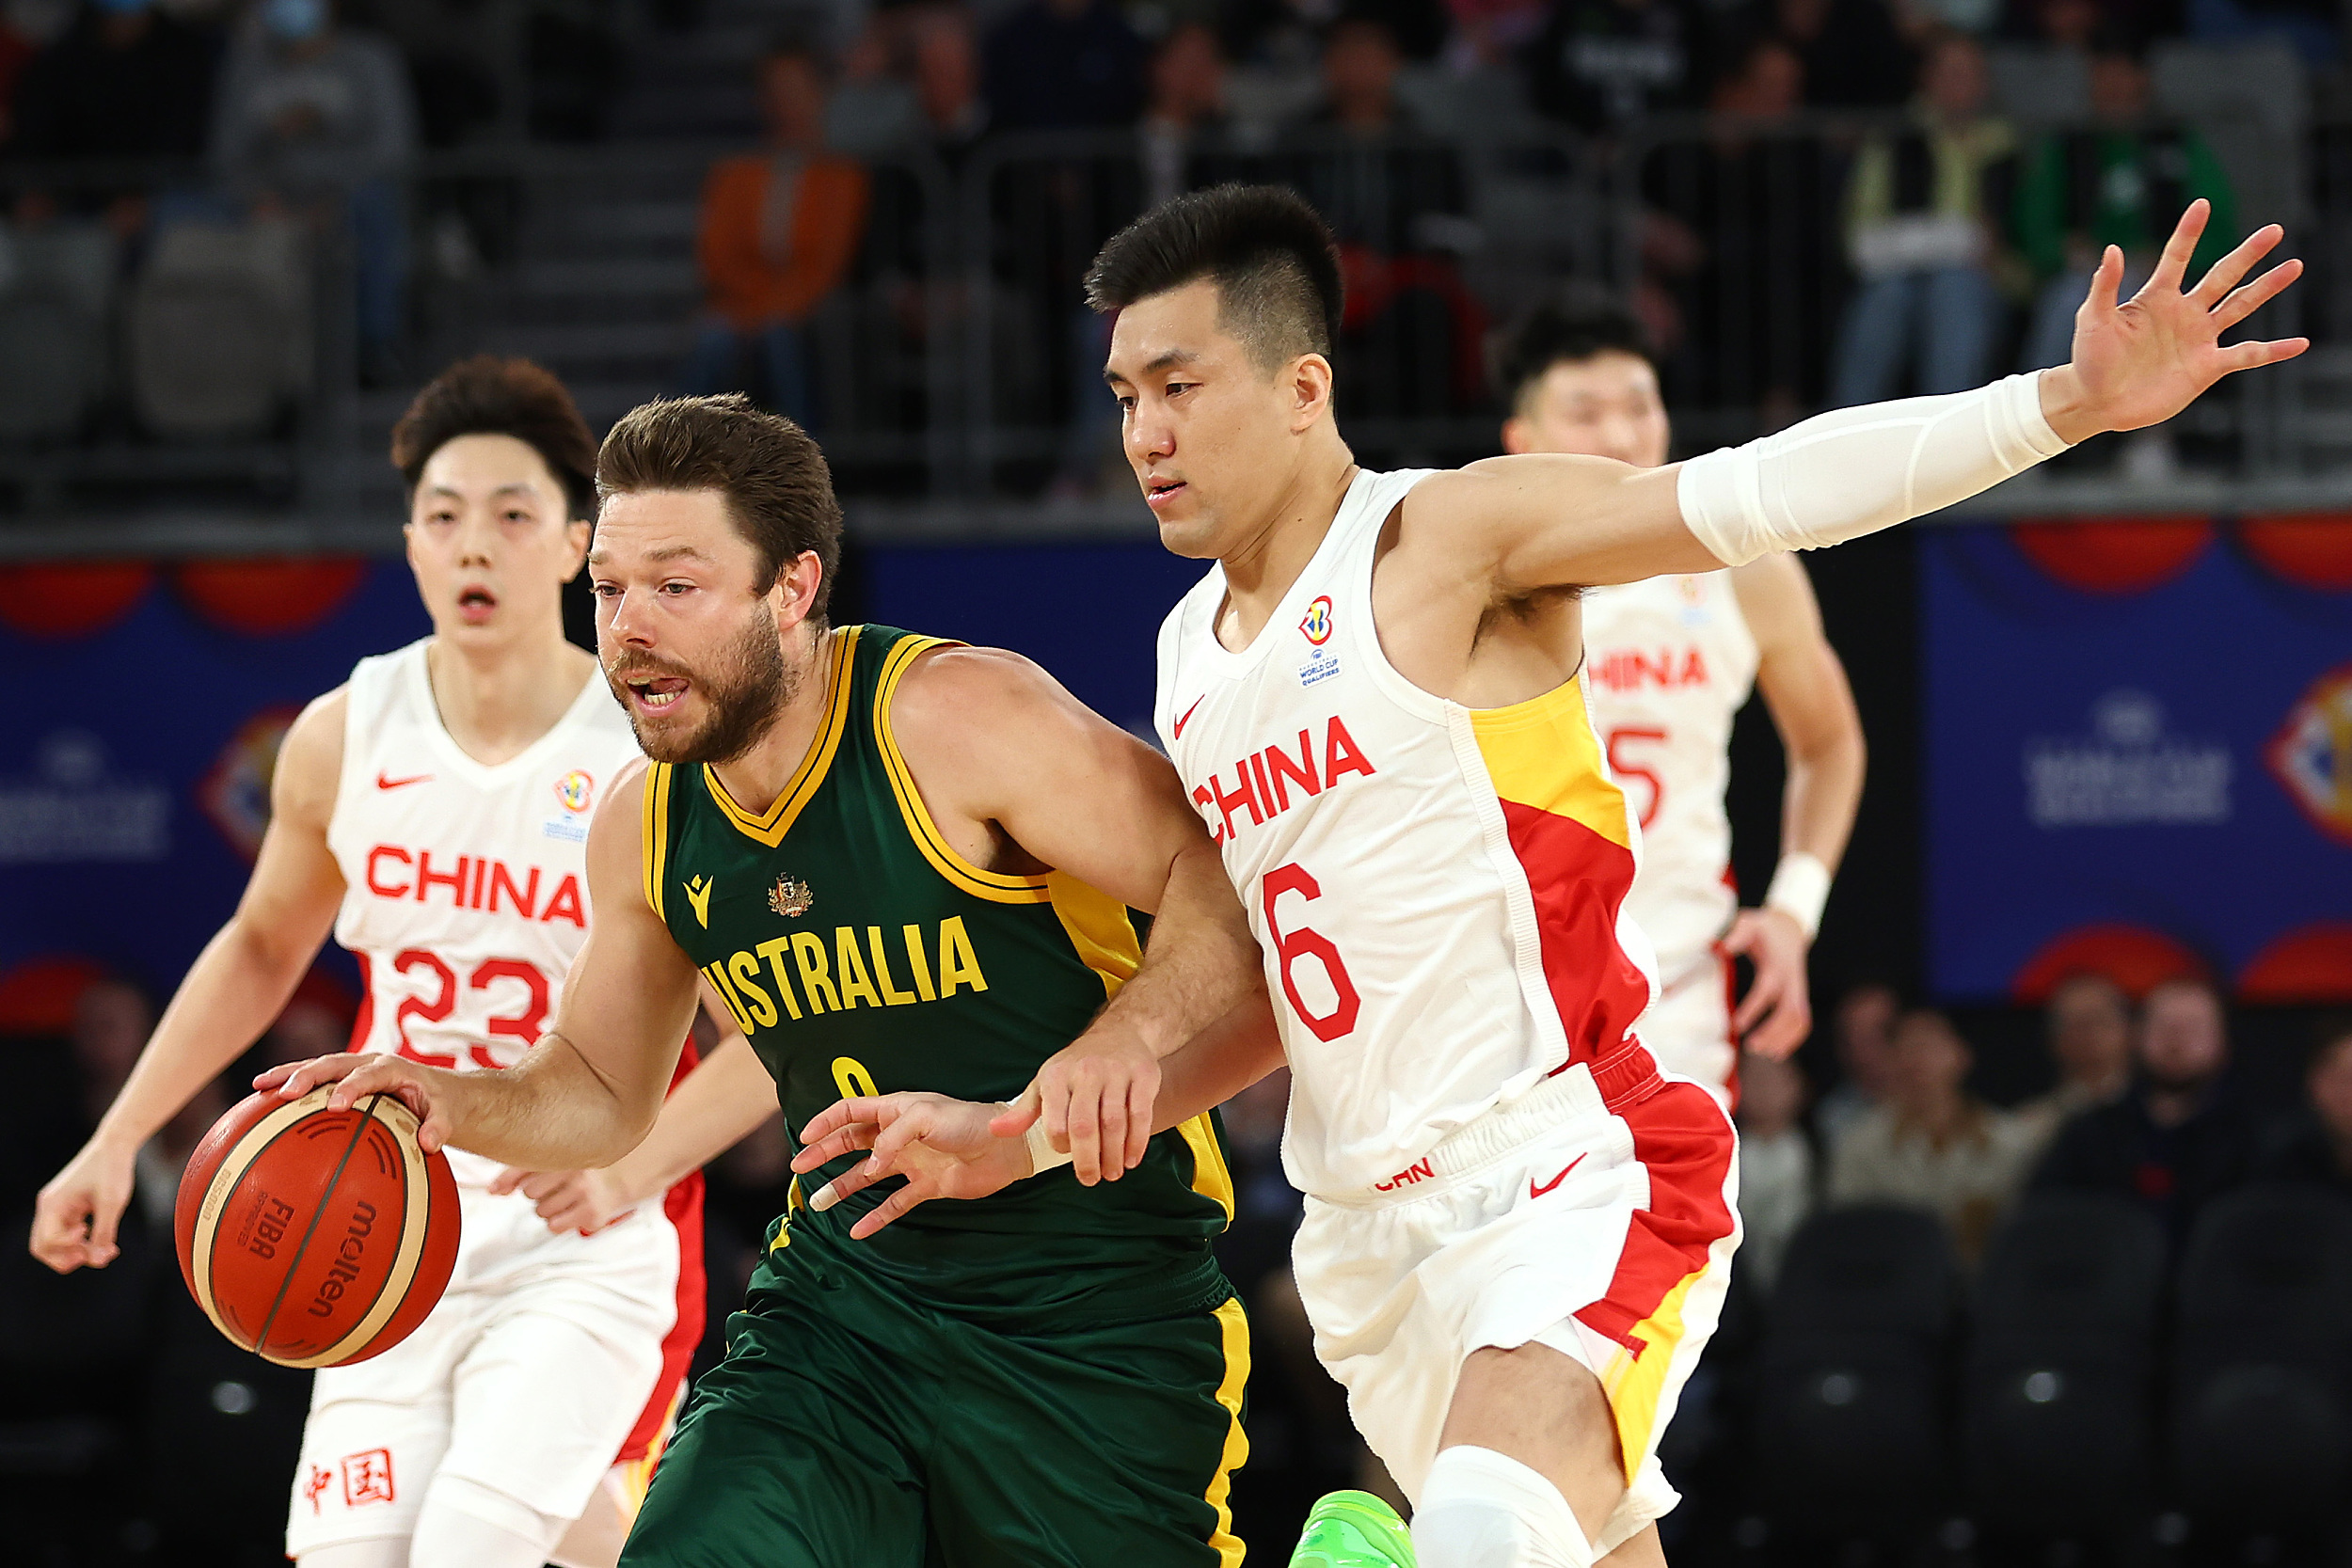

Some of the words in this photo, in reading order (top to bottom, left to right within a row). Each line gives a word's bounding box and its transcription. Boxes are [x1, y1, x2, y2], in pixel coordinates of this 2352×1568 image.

[1300, 663, 1324, 678] WORLD
[1326, 658, 1338, 670] CUP
[1302, 667, 1340, 686] QUALIFIERS
[1588, 646, 1710, 692] HINA
[368, 846, 586, 928] CHINA
[701, 915, 989, 1036] USTRALIA
[1263, 862, 1361, 1043] 6
[394, 949, 548, 1069] 23
[248, 1196, 295, 1260] FIBA
[307, 1200, 377, 1318] molten
[304, 1448, 394, 1516] 中国
